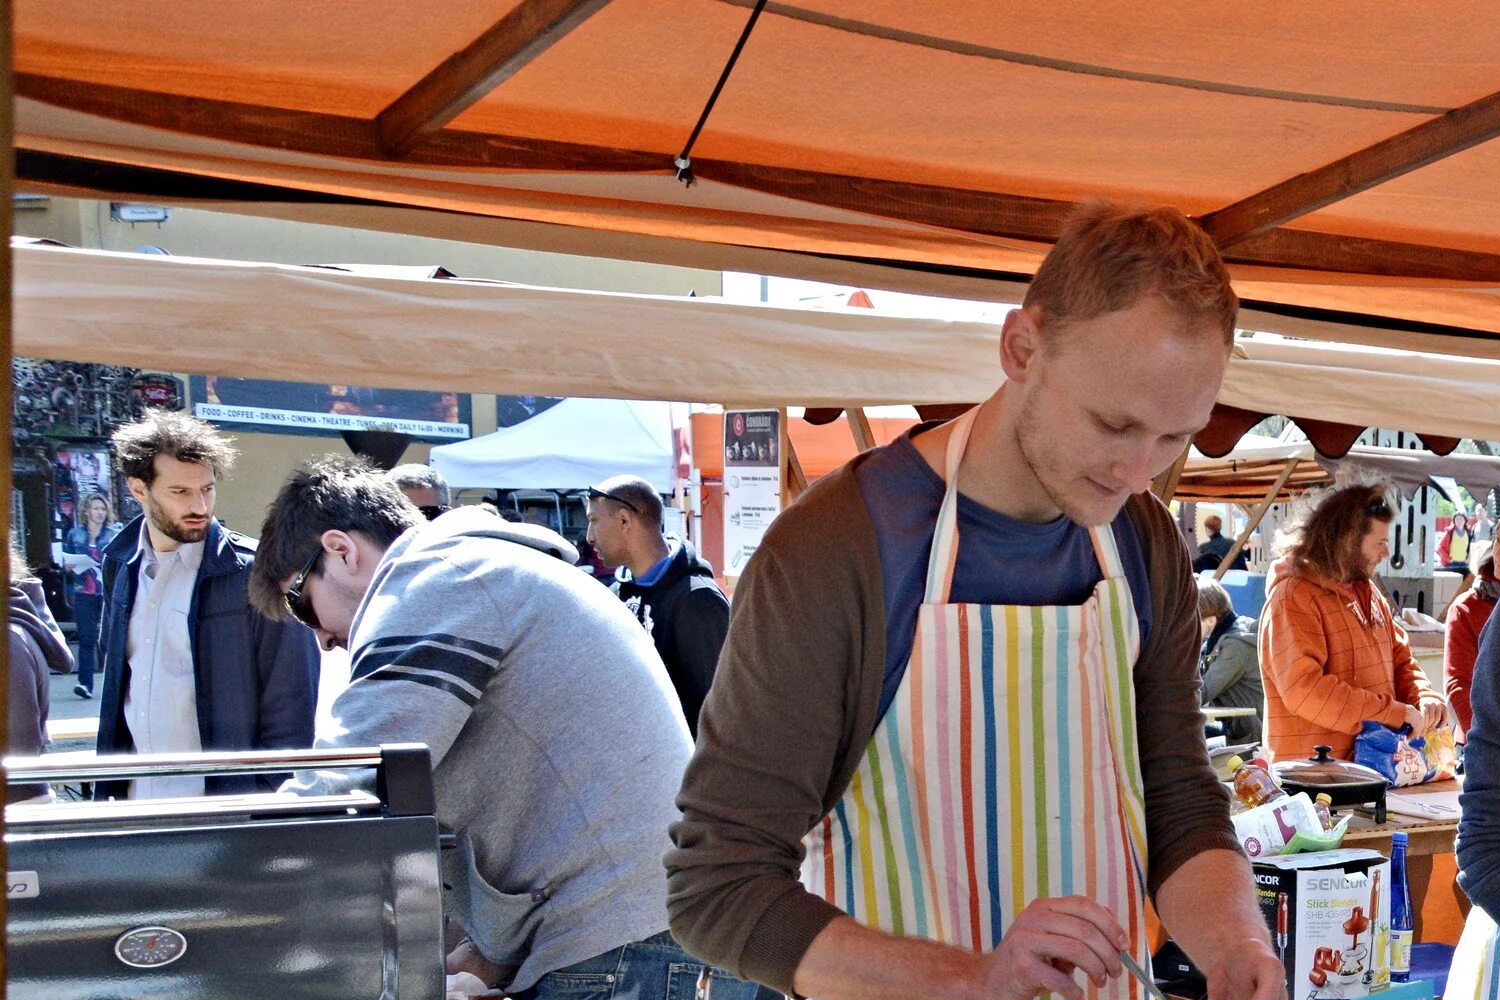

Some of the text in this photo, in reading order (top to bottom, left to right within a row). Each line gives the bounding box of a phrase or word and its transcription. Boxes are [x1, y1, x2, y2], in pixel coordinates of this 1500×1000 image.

[201, 407, 221, 417] FOOD
[227, 409, 254, 419] COFFEE
[260, 412, 285, 421] DRINKS
[291, 414, 316, 424] CINEMA
[322, 417, 351, 426] THEATRE
[437, 425, 464, 434] MORNING
[1253, 873, 1280, 886] NCOR
[1306, 898, 1329, 909] Stick
